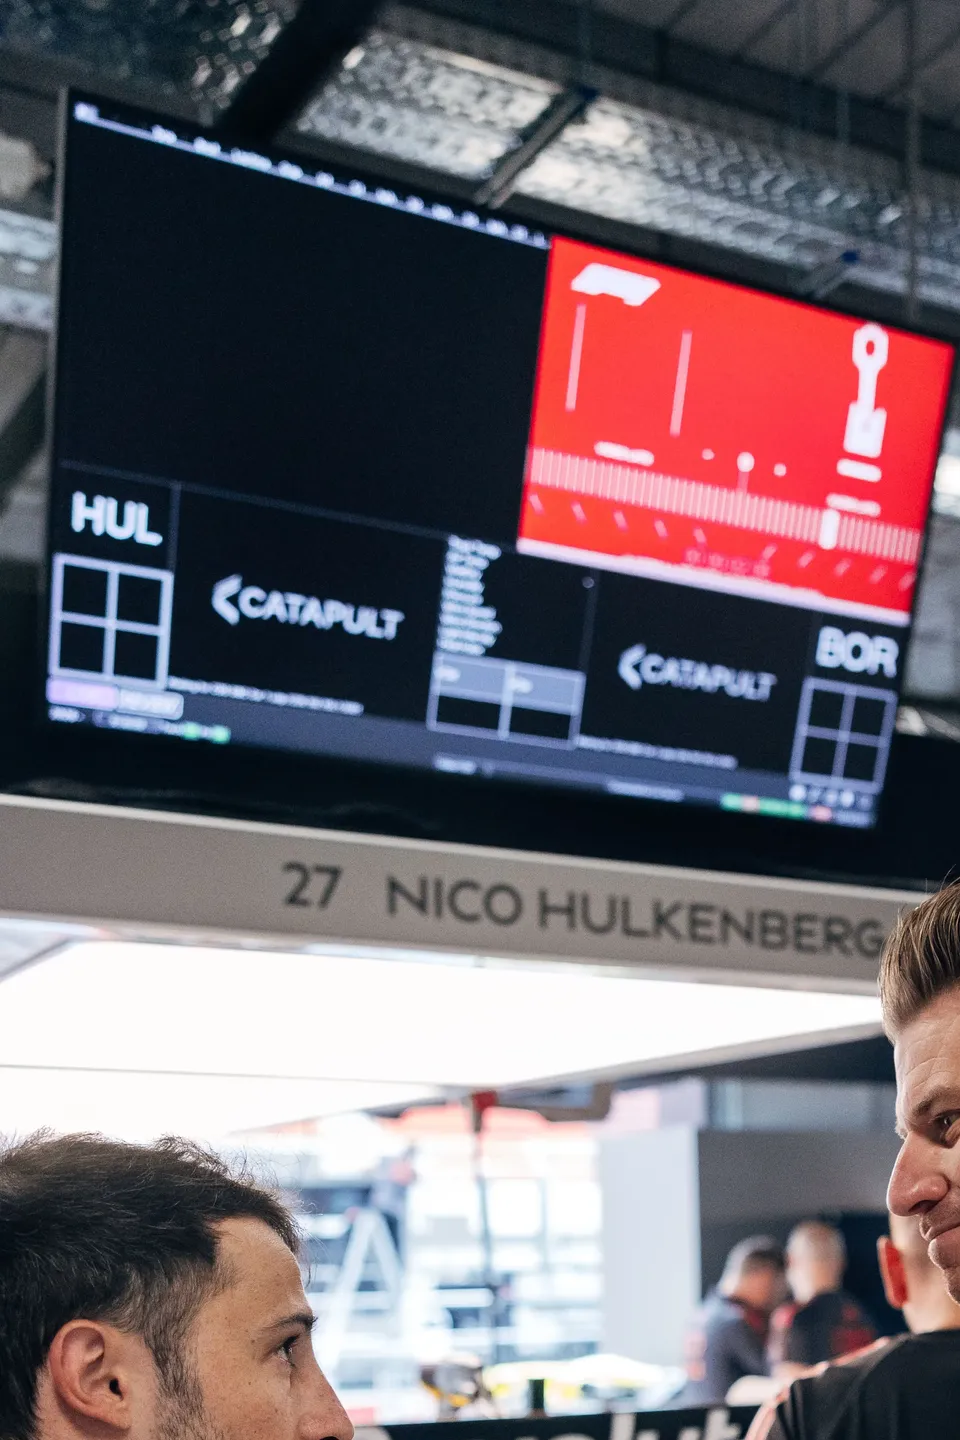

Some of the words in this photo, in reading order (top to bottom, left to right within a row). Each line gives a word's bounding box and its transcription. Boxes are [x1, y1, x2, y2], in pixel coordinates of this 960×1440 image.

[70, 491, 163, 546] HUL
[236, 584, 404, 640] CATAPULT
[640, 655, 777, 701] CATAPULT
[815, 625, 900, 679] BOR
[280, 861, 344, 910] 27
[385, 875, 524, 927] NICO
[537, 887, 885, 960] HULKENBERG
